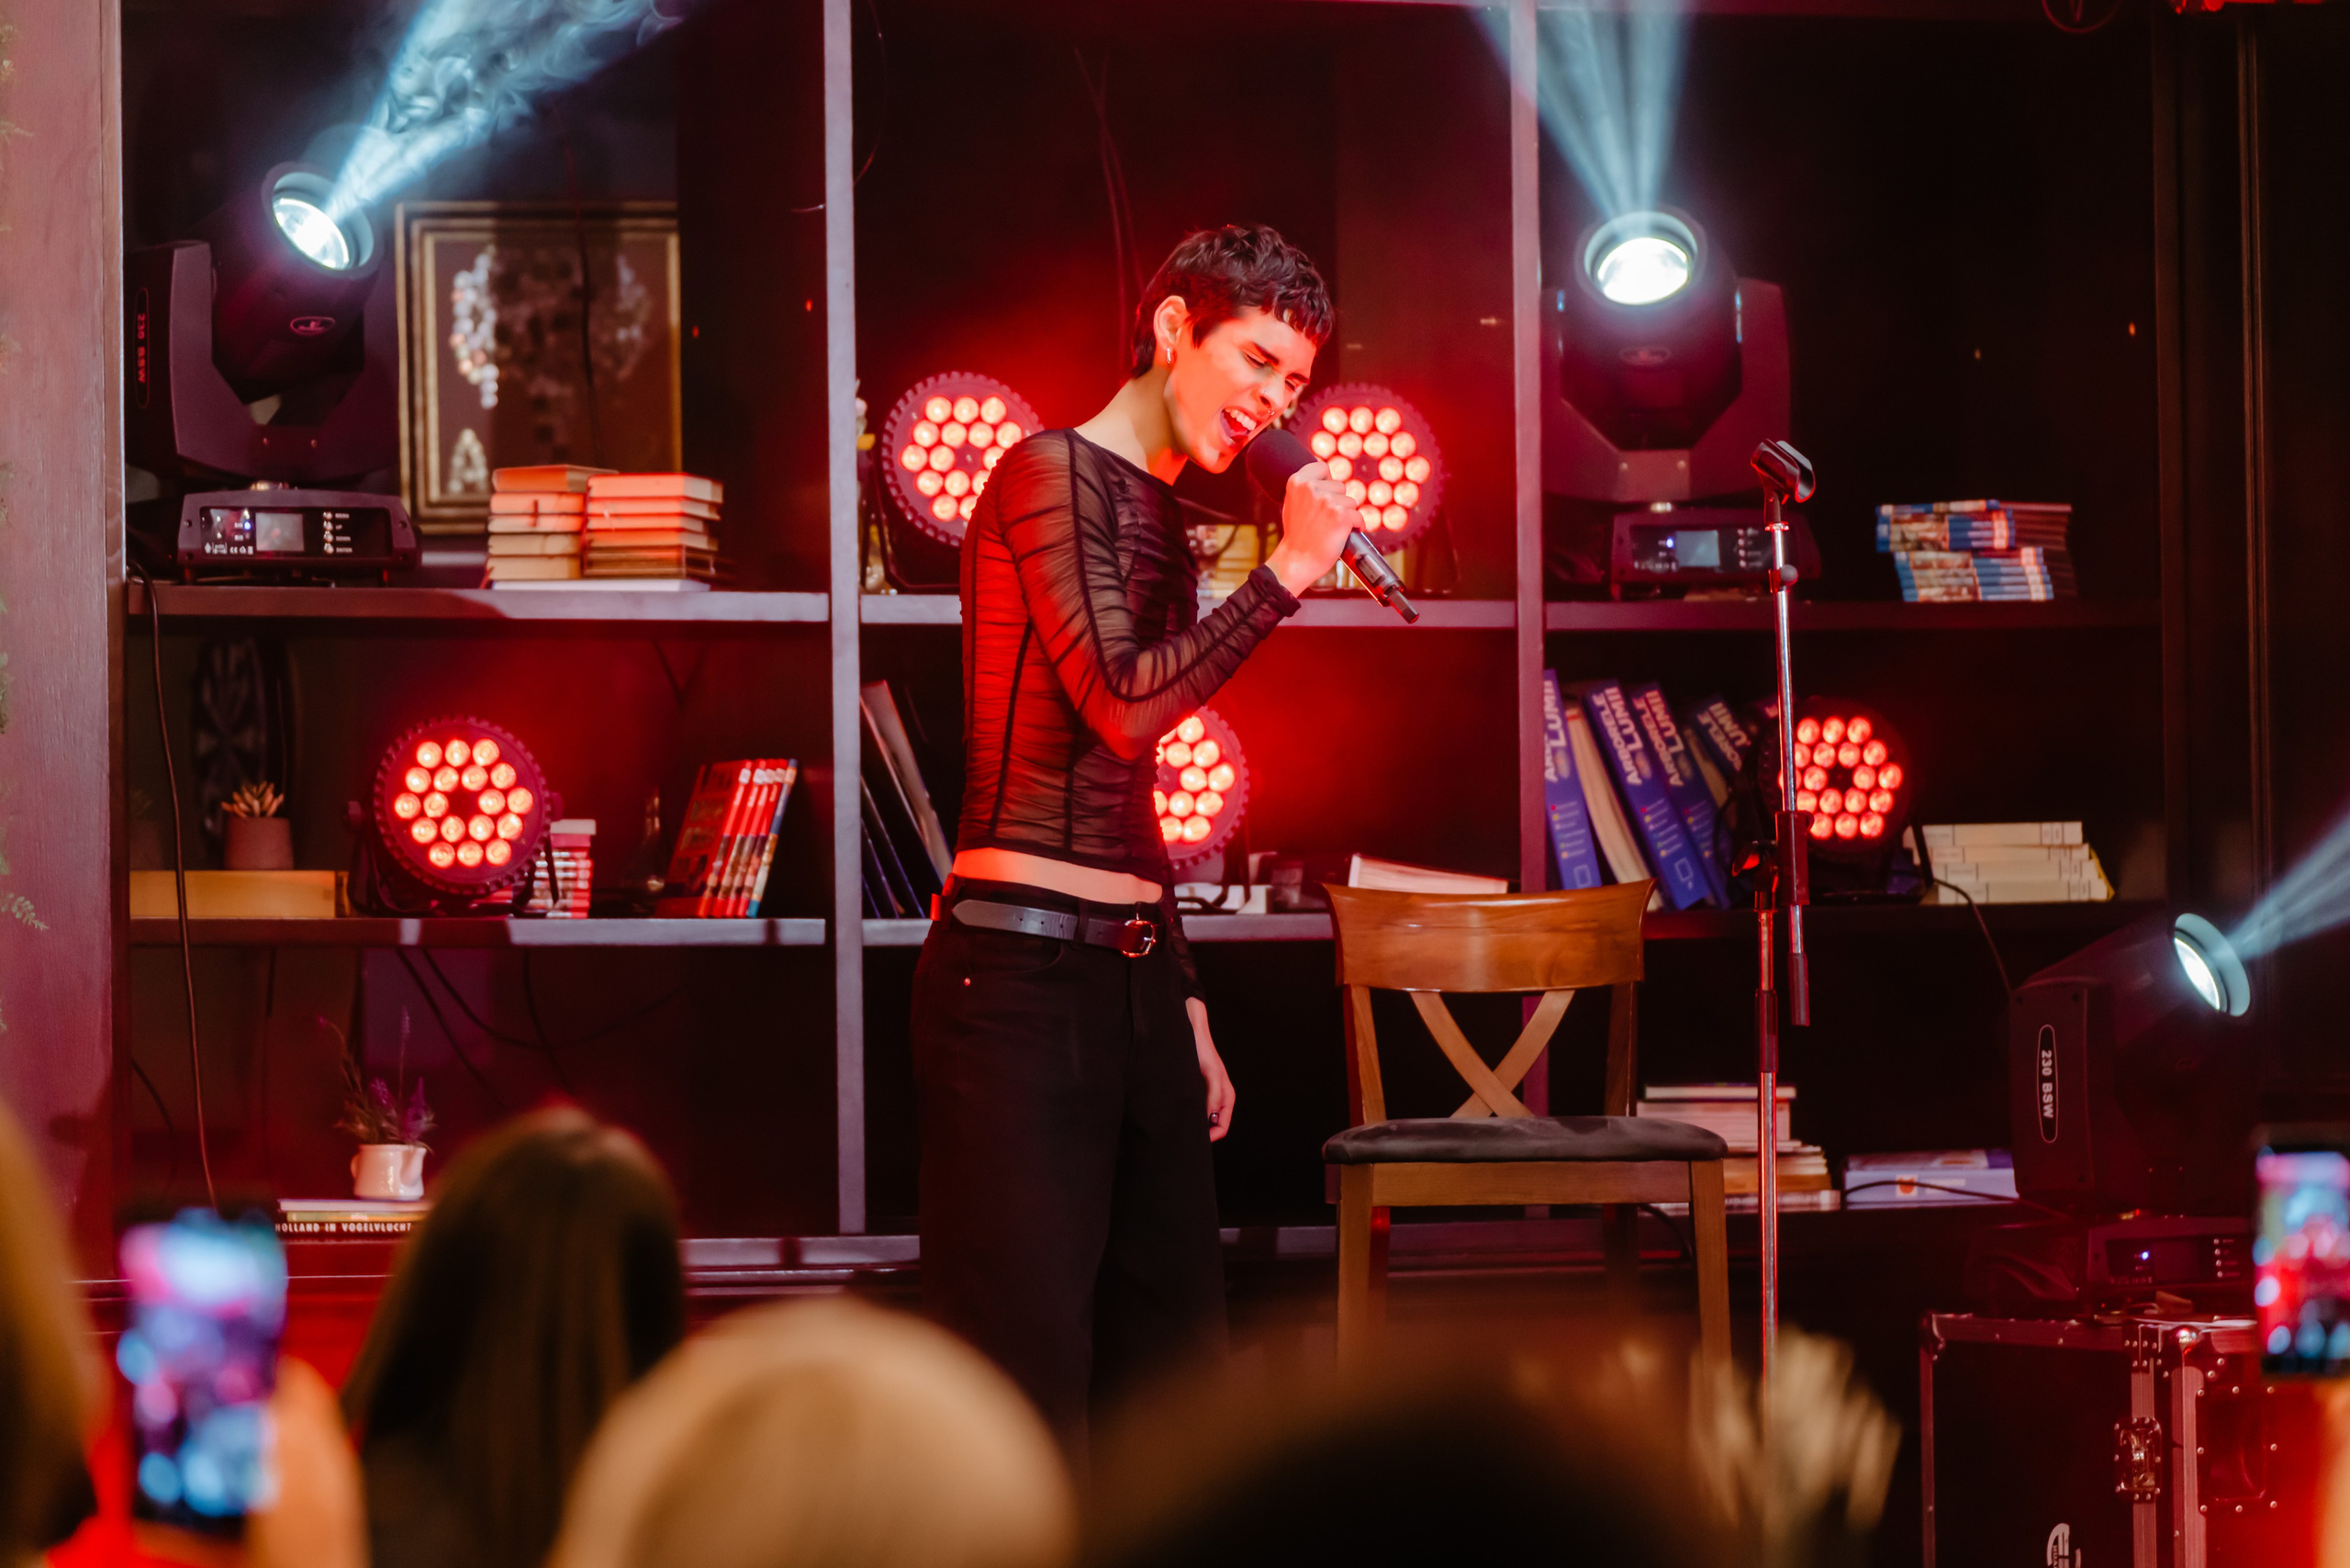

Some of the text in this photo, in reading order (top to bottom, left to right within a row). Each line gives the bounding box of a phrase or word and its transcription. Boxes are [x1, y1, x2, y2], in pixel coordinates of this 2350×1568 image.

[137, 313, 146, 384] 230 BSW
[1593, 692, 1643, 786] ARBORELE
[1605, 686, 1644, 752] LUMII
[1632, 698, 1684, 786] ARBORELE
[1645, 689, 1685, 754] LUMII
[1708, 701, 1751, 747] UMII
[2042, 1049, 2054, 1118] 230 BSW
[275, 1222, 412, 1233] HOLLAND IN VOGELVLUCHT
